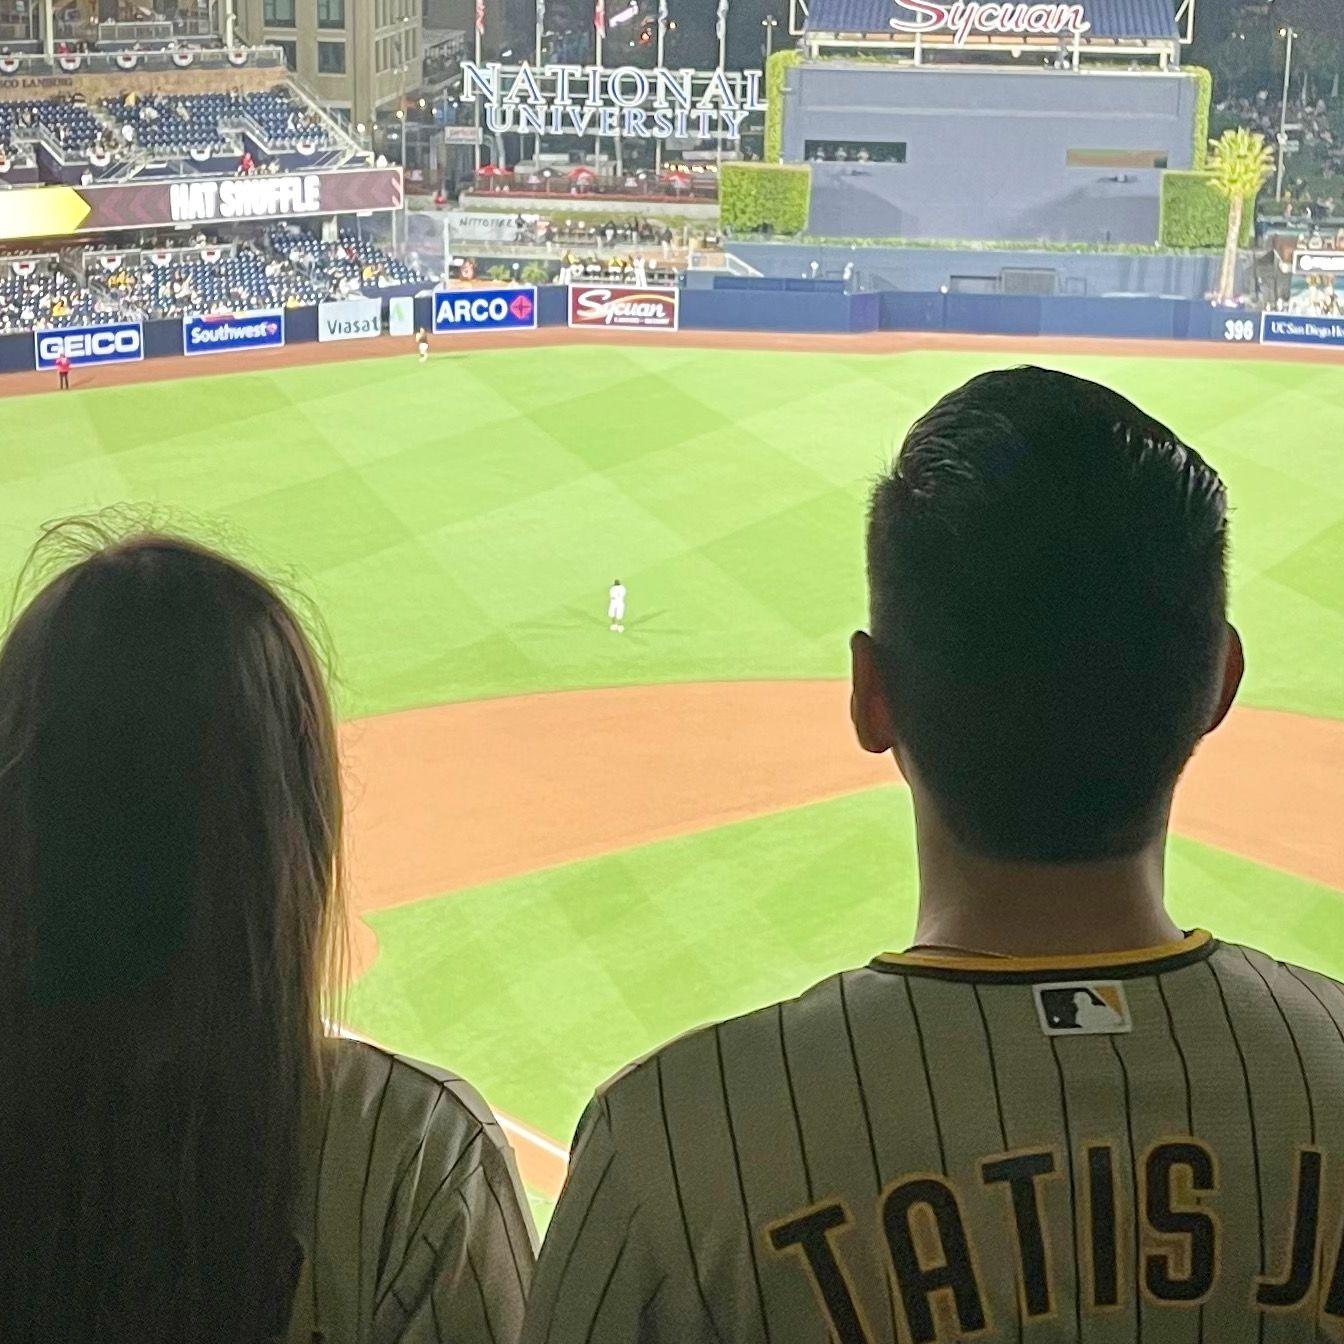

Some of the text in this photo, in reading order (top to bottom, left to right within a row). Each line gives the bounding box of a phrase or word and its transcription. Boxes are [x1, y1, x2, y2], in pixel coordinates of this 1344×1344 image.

[459, 60, 768, 111] NATIONAL
[485, 103, 749, 140] UNIVERSITY
[169, 174, 320, 221] HAT SHUFFLE
[436, 297, 508, 324] ARCO
[576, 289, 666, 324] Sycuan
[191, 321, 267, 345] Southwest
[326, 316, 380, 335] Viasat
[40, 330, 140, 360] GEICO
